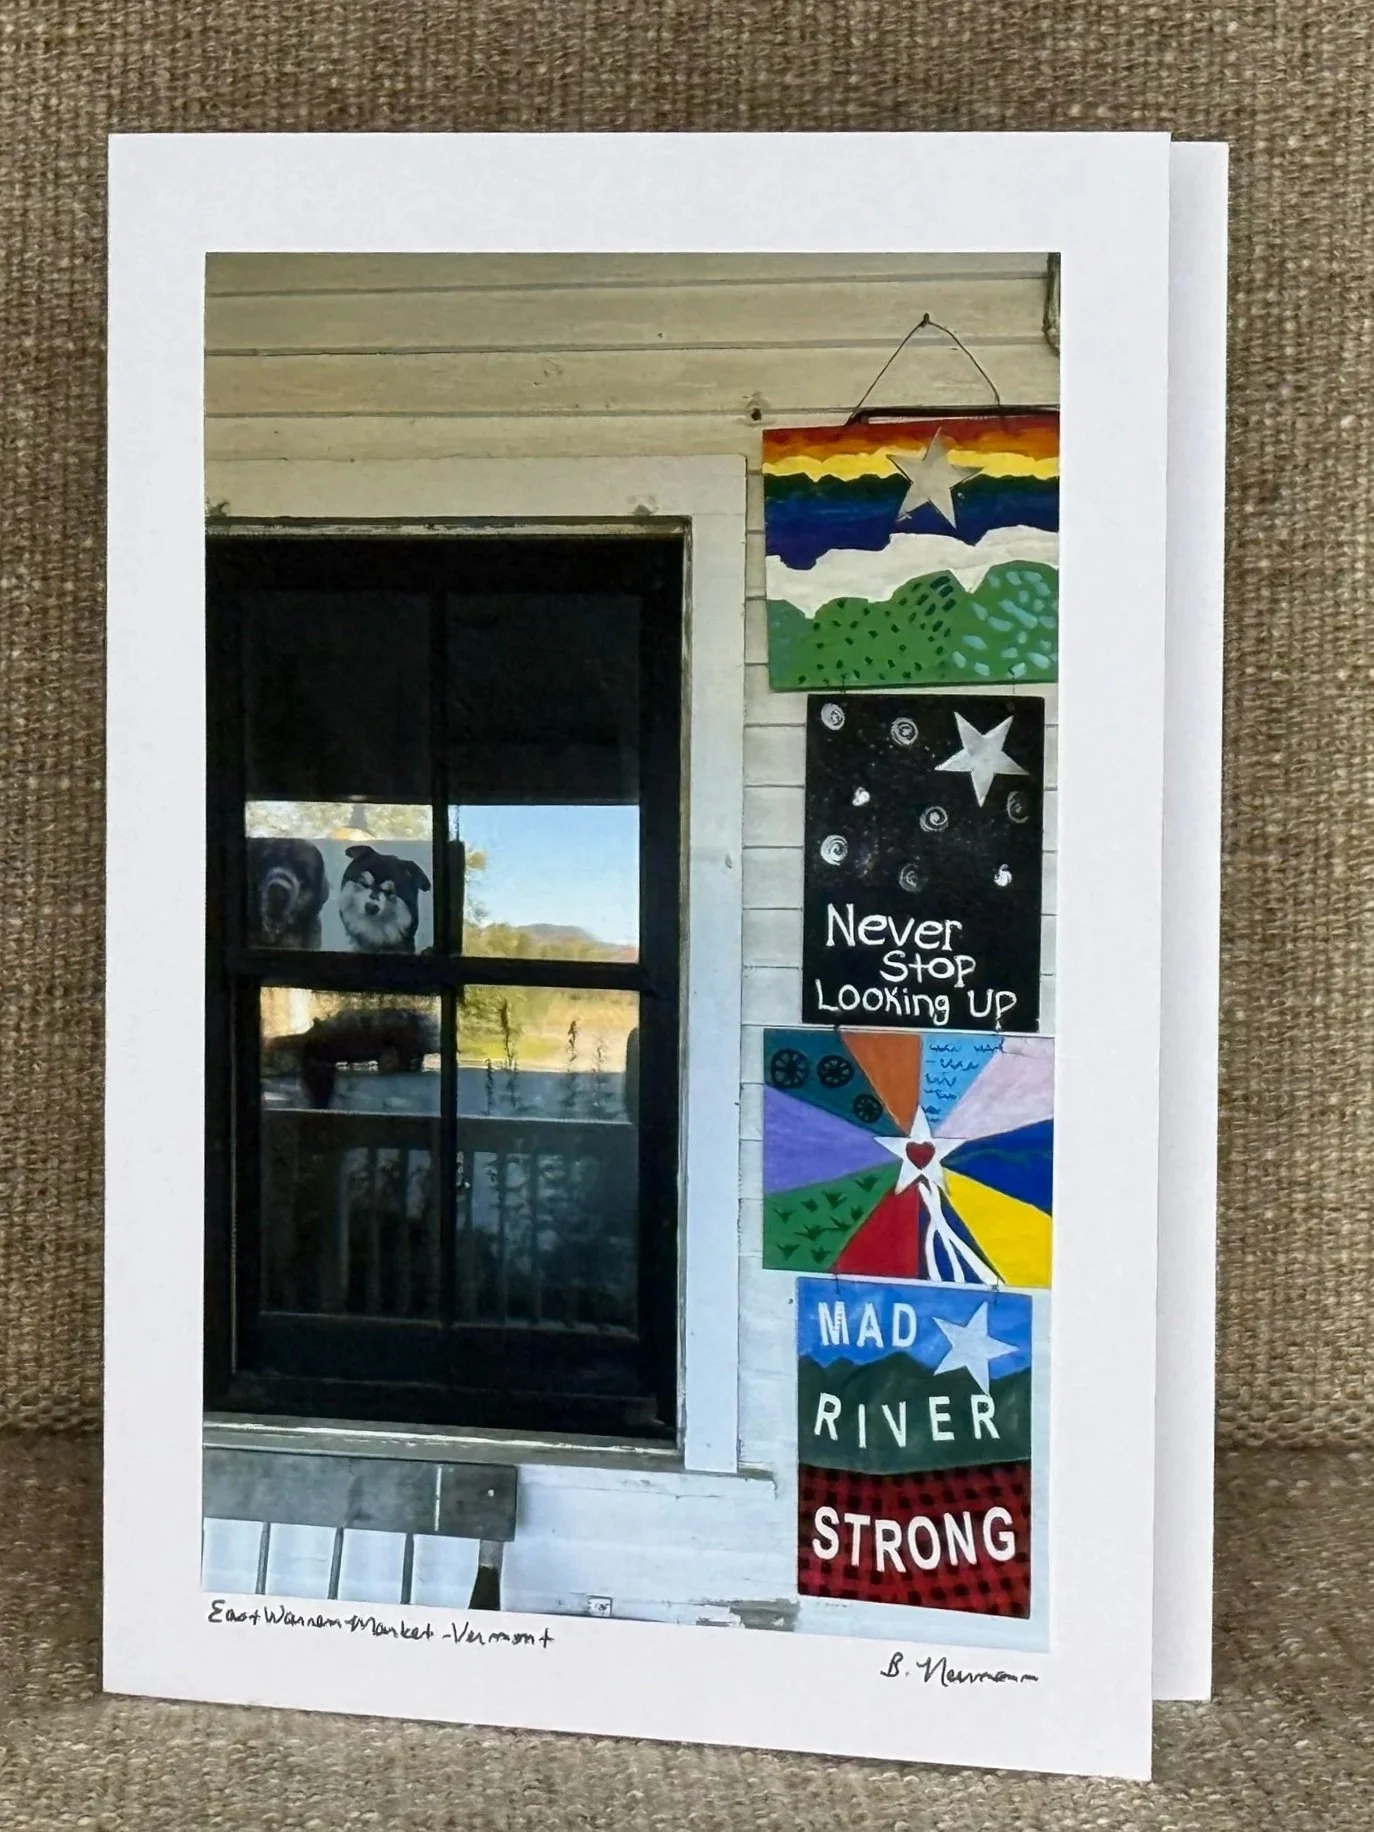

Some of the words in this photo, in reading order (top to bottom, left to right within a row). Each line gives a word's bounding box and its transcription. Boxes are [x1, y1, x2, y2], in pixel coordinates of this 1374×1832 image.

[826, 903, 963, 951] Never
[818, 1301, 917, 1349] MAD
[814, 1392, 1001, 1449] RIVER
[812, 1506, 1016, 1573] STRONG
[208, 1599, 261, 1626] East
[264, 1605, 342, 1630] Warren
[880, 1651, 910, 1678] B.
